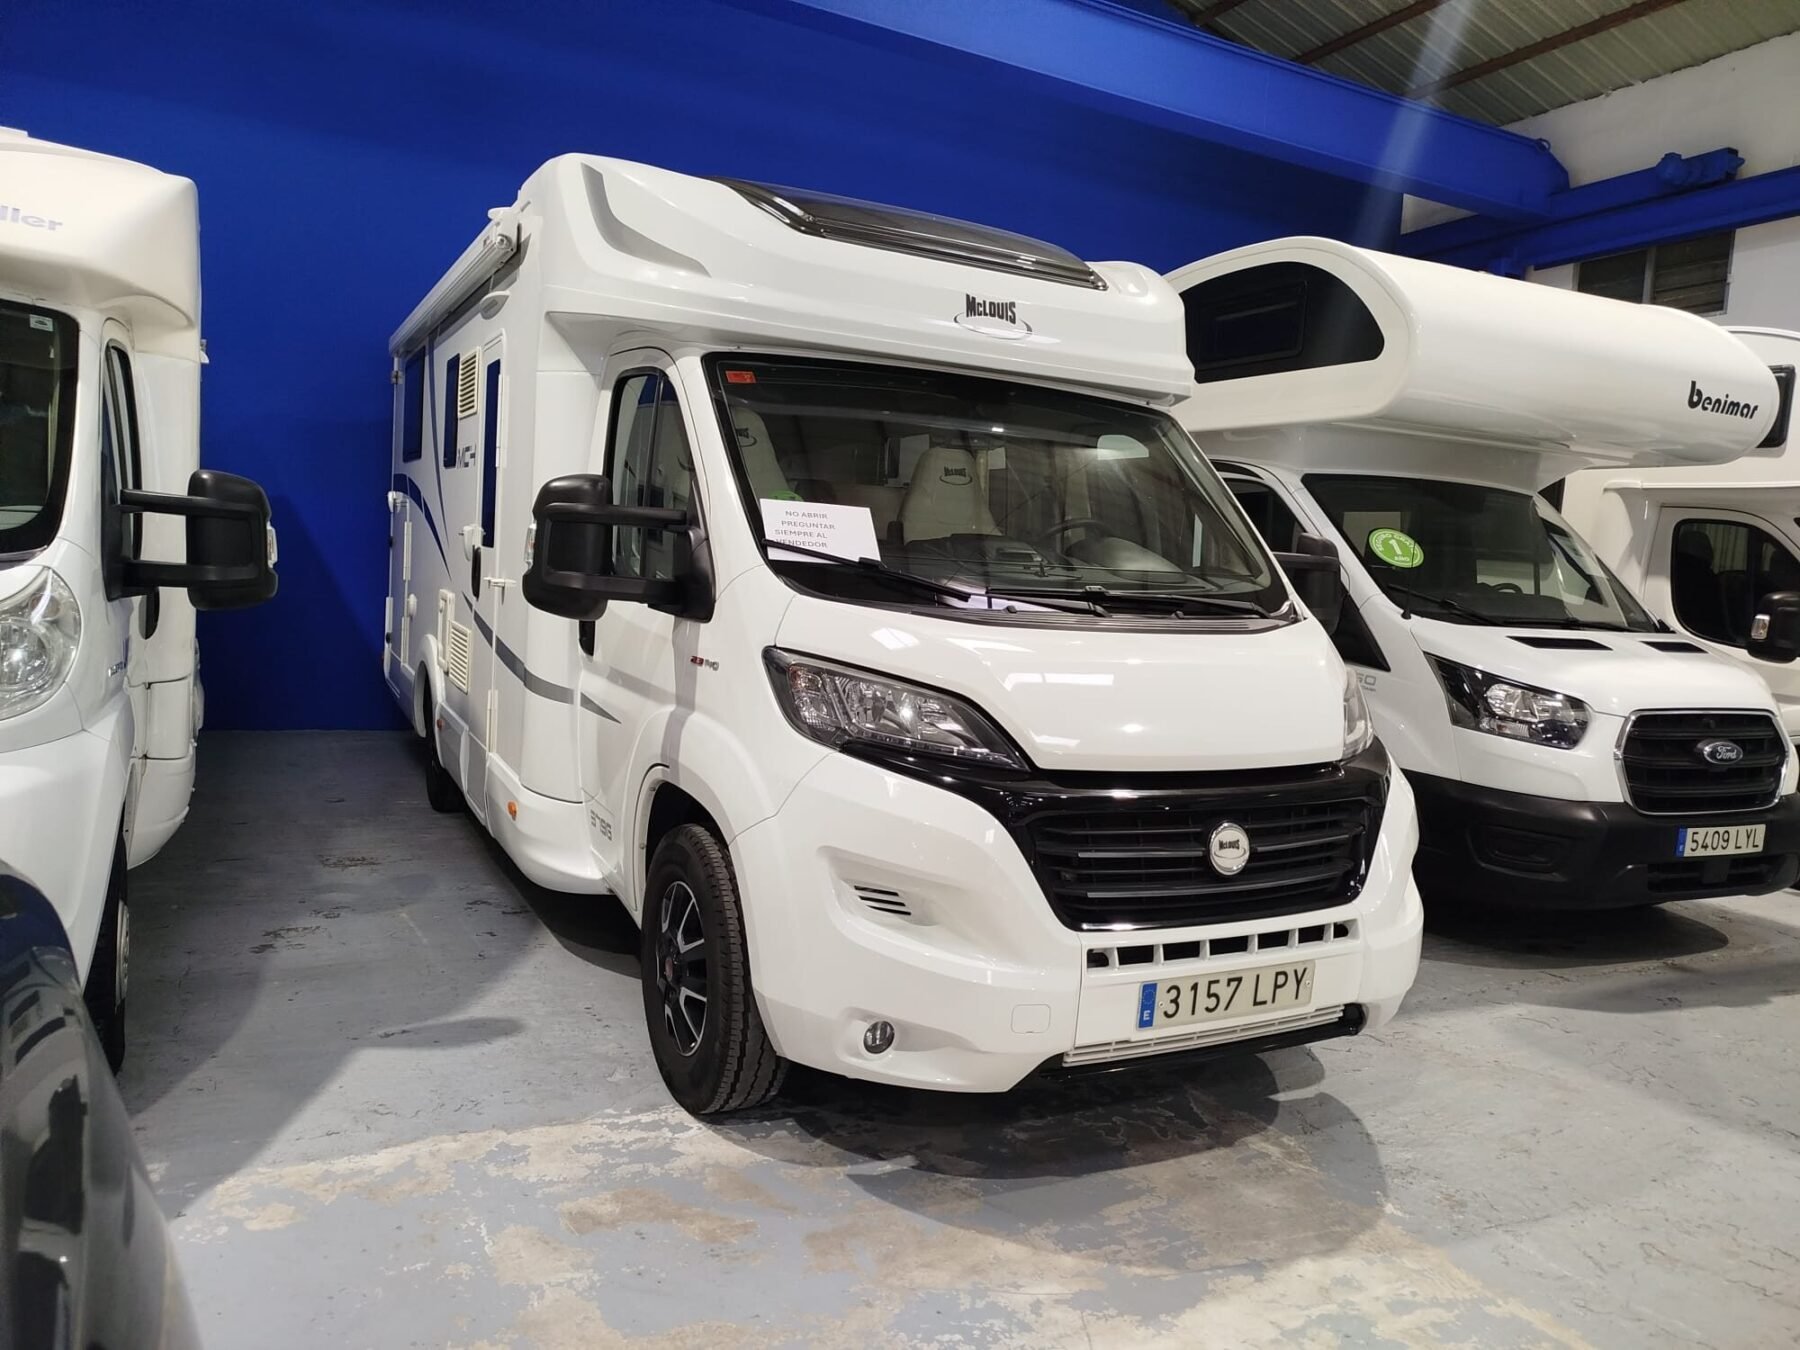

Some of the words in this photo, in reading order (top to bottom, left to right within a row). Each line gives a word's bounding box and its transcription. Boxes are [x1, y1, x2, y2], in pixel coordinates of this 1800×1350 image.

[1688, 380, 1758, 419] benimar
[801, 512, 828, 520] ABRIR
[781, 520, 836, 530] PREGUNTAR
[774, 529, 815, 538] SIEMPRE
[1388, 539, 1402, 555] 1
[1716, 745, 1737, 760] Ford
[1690, 830, 1730, 852] 5409
[1734, 828, 1759, 850] LYL
[1143, 1010, 1151, 1021] E
[1163, 976, 1243, 1019] 3157
[1252, 967, 1308, 1007] LPY
